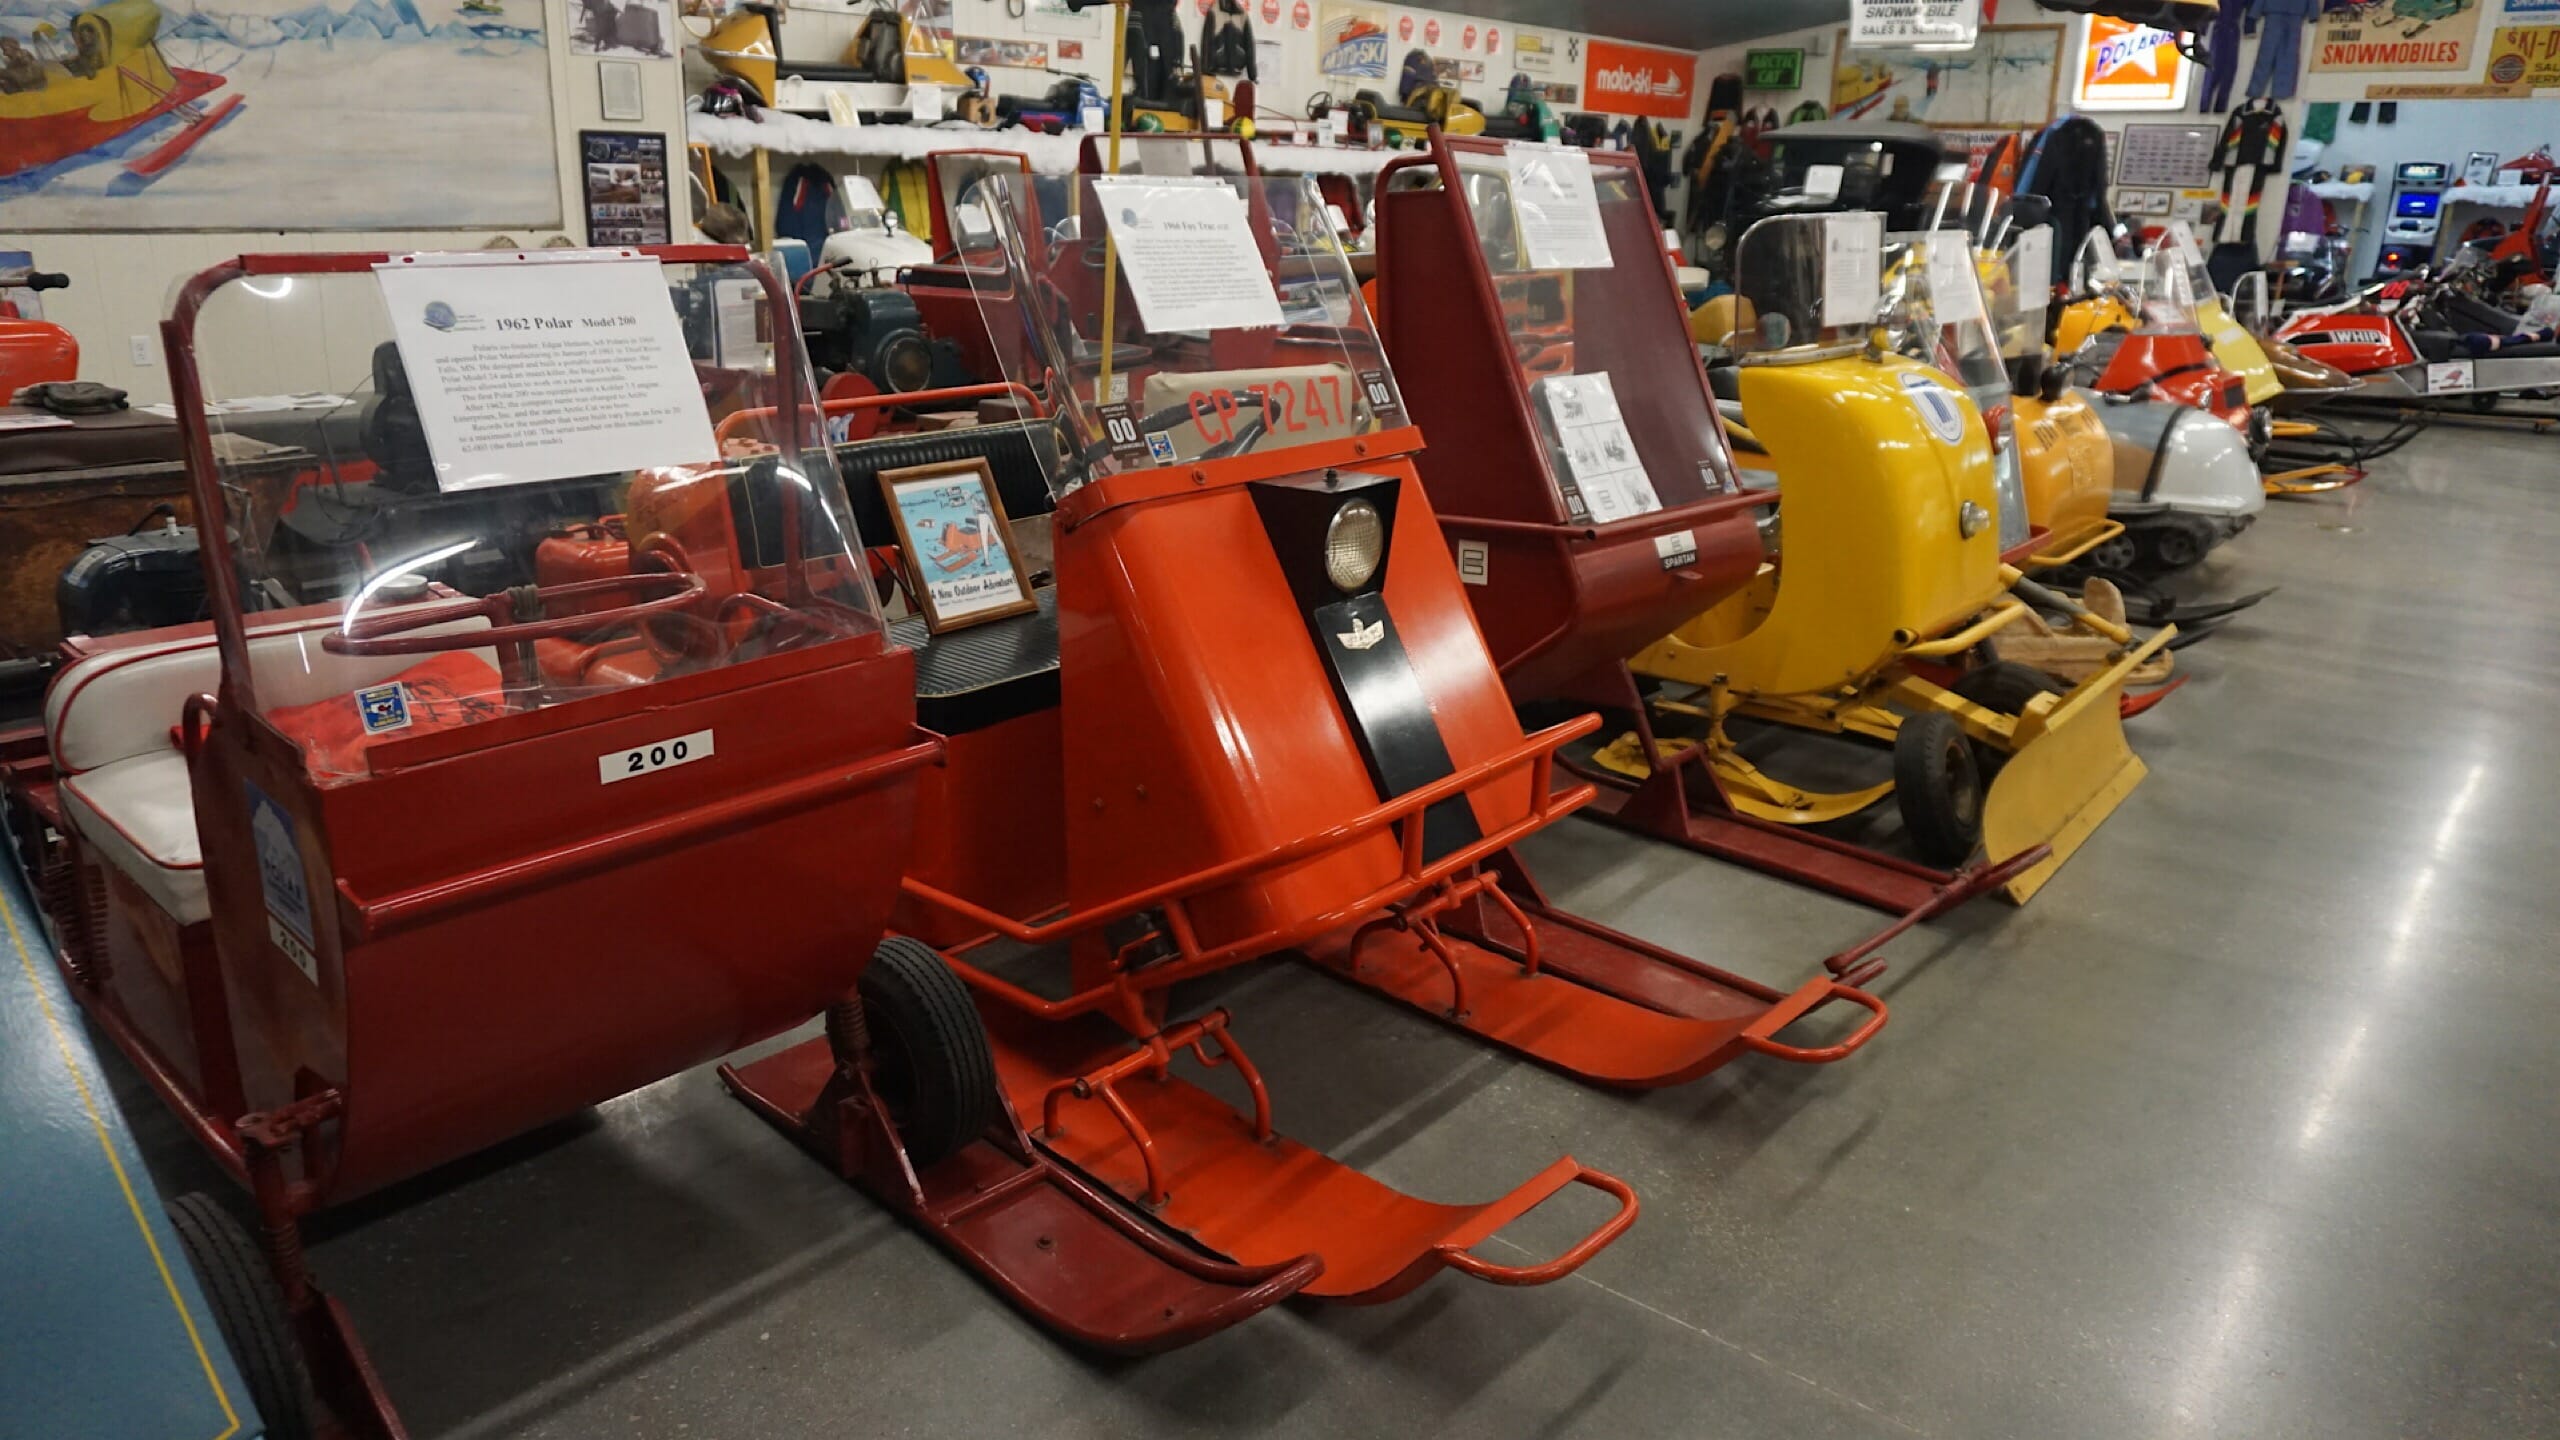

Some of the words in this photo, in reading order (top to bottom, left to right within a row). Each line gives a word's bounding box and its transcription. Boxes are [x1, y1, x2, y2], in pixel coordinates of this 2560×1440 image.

[1865, 4, 1959, 18] SNOWMBILE
[2096, 31, 2175, 73] POLARIS
[2322, 41, 2460, 65] SNOWMOBILES
[496, 317, 531, 331] 1962
[534, 316, 574, 329] Polar
[581, 317, 616, 328] Model
[617, 315, 637, 326] 200
[2335, 330, 2381, 344] WHIP
[1367, 382, 1390, 404] 00
[1187, 387, 1239, 444] CP
[1247, 375, 1345, 436] 7247
[1107, 417, 1137, 443] 00
[1663, 550, 1696, 569] SPARTAN
[627, 741, 689, 772] 200
[279, 929, 308, 970] 200
